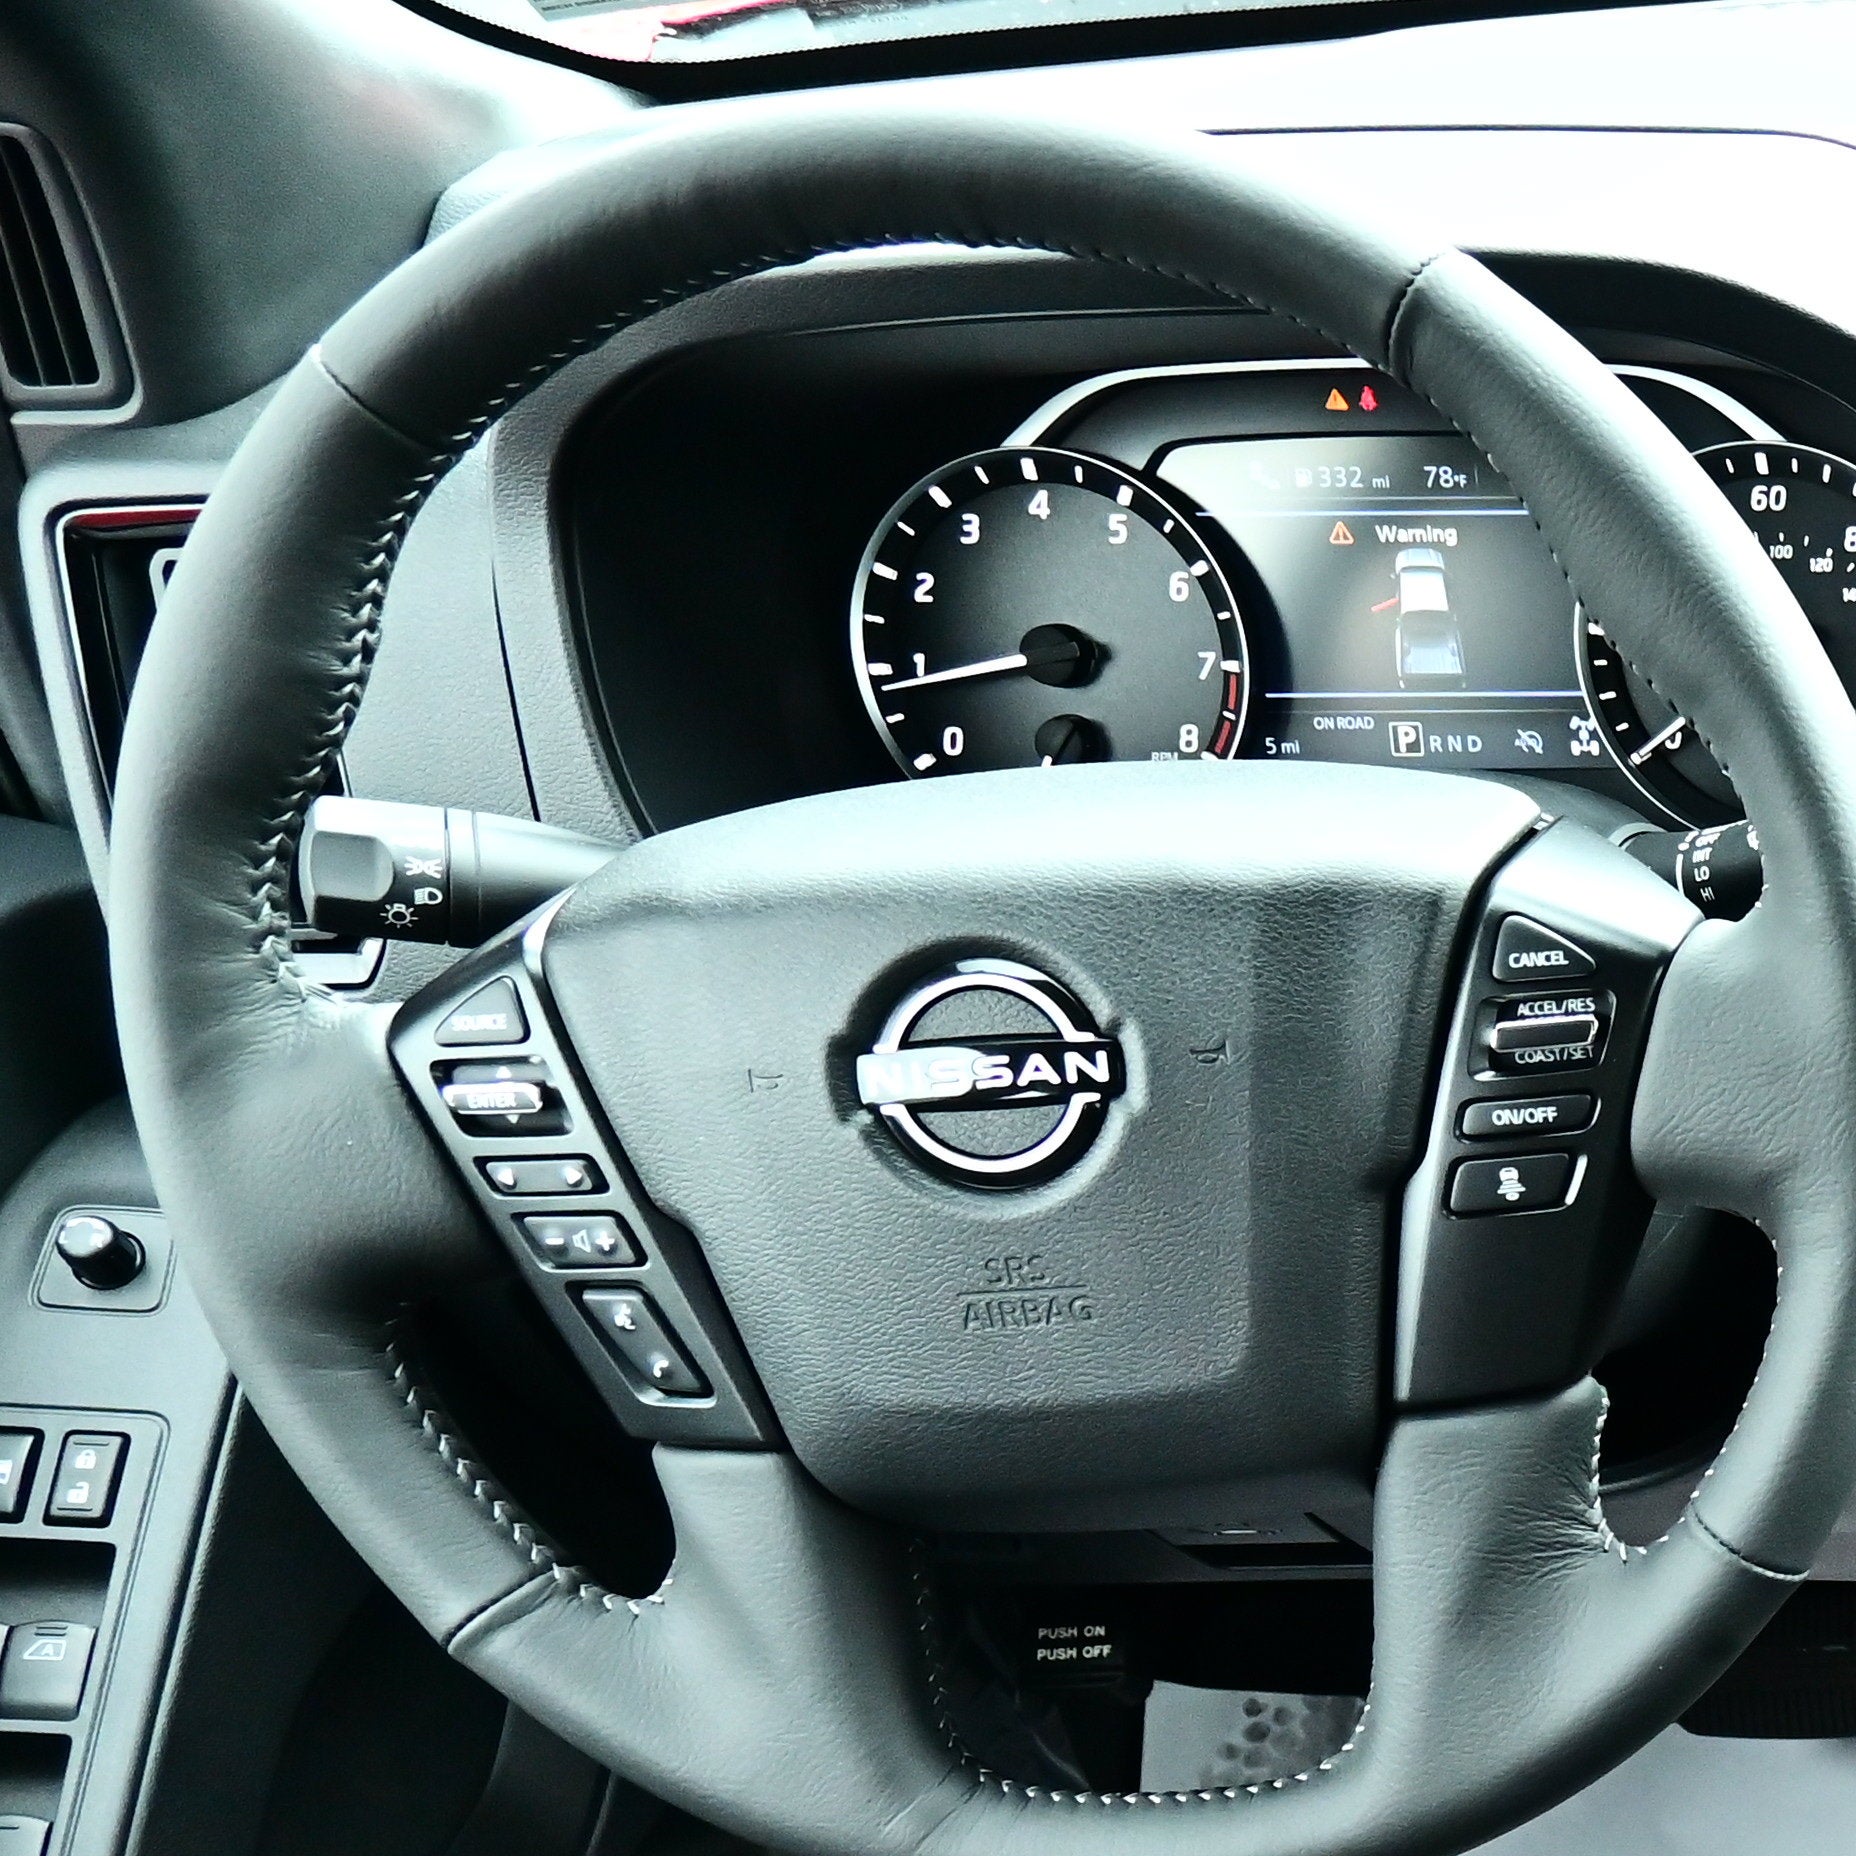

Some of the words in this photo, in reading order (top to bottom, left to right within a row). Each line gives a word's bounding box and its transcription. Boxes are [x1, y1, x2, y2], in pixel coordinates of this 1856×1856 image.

[1318, 466, 1364, 488] 332
[1372, 475, 1390, 489] mi
[1028, 489, 1050, 520] 4
[1750, 485, 1787, 511] 60
[960, 513, 980, 544] 3
[1108, 513, 1128, 544] 5
[1375, 524, 1458, 547] Warning
[1769, 544, 1793, 559] 100
[1809, 557, 1833, 572] 120
[914, 572, 934, 602] 2
[1169, 571, 1189, 602] 6
[913, 652, 925, 677] 1
[1197, 651, 1216, 680] 7
[1313, 716, 1335, 730] ON
[1337, 716, 1375, 730] ROAD
[943, 726, 964, 757] 0
[1179, 724, 1199, 753] 8
[1265, 737, 1277, 755] 5
[1281, 739, 1300, 755] mi
[1398, 725, 1417, 753] P
[1430, 736, 1443, 753] R
[1448, 735, 1462, 752] N
[1468, 735, 1482, 752] D
[1694, 866, 1710, 882] LO
[1700, 887, 1716, 902] HI
[1508, 950, 1569, 969] CANCEL
[1517, 997, 1596, 1016] ACCEL/RES
[1514, 1046, 1595, 1065] COAST/SET
[863, 1050, 1110, 1099] NISSAN
[1491, 1106, 1558, 1126] ON/OFF
[984, 1254, 1047, 1284] SRS
[963, 1294, 1092, 1330] AIRBAG
[1037, 1626, 1078, 1640] PUSH
[1084, 1625, 1106, 1638] ON
[1036, 1646, 1077, 1661] PUSH
[1082, 1644, 1112, 1660] OFF
